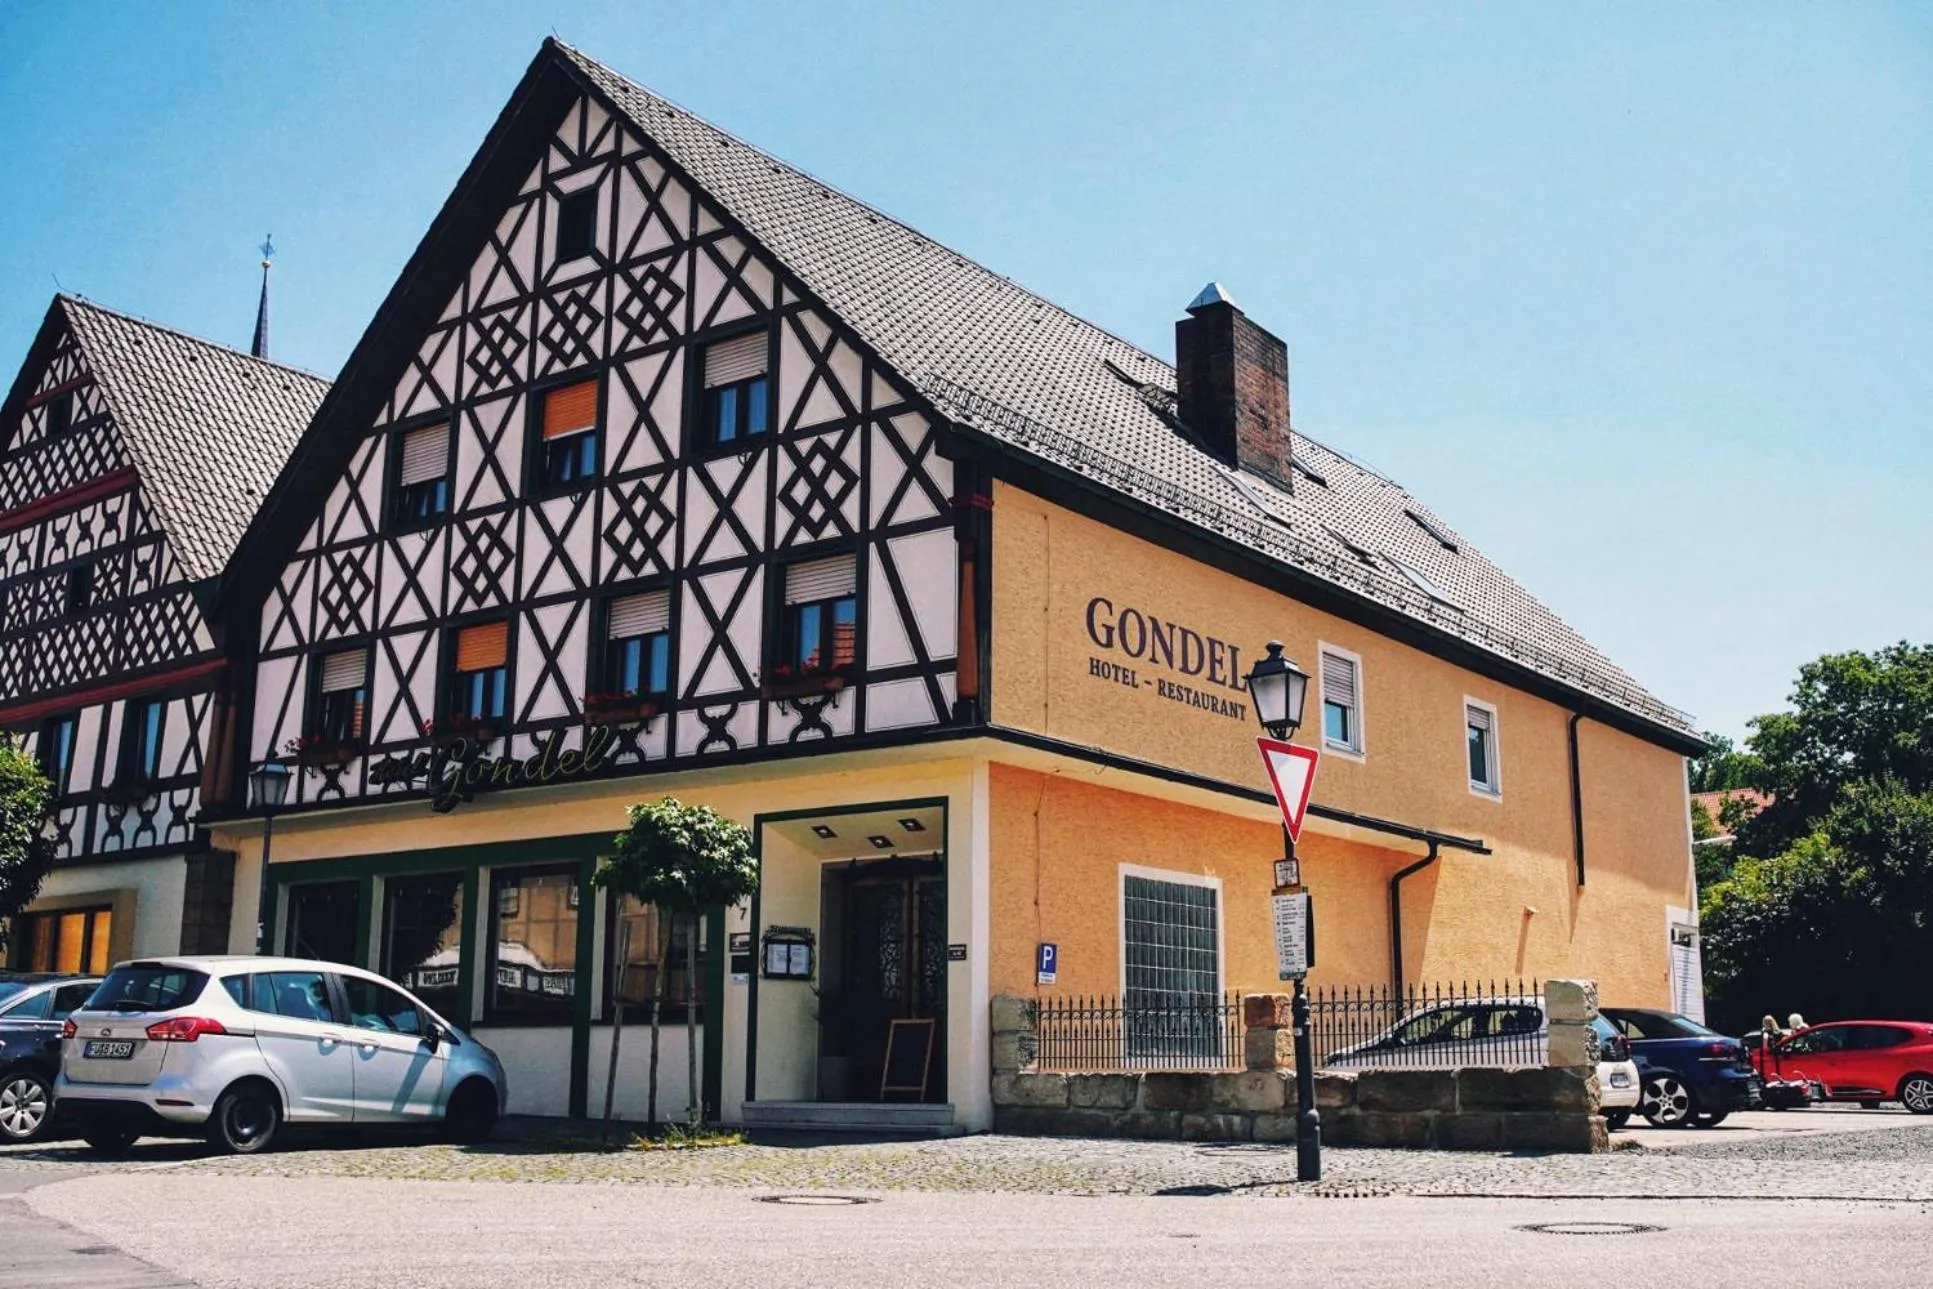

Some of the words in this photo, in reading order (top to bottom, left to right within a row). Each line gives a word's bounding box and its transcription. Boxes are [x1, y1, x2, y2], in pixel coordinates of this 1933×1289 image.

[1086, 597, 1247, 693] GONDEL
[1089, 656, 1139, 689] HOTEL
[1157, 677, 1247, 721] RESTAURANT
[740, 907, 747, 920] 7
[1043, 945, 1054, 969] P
